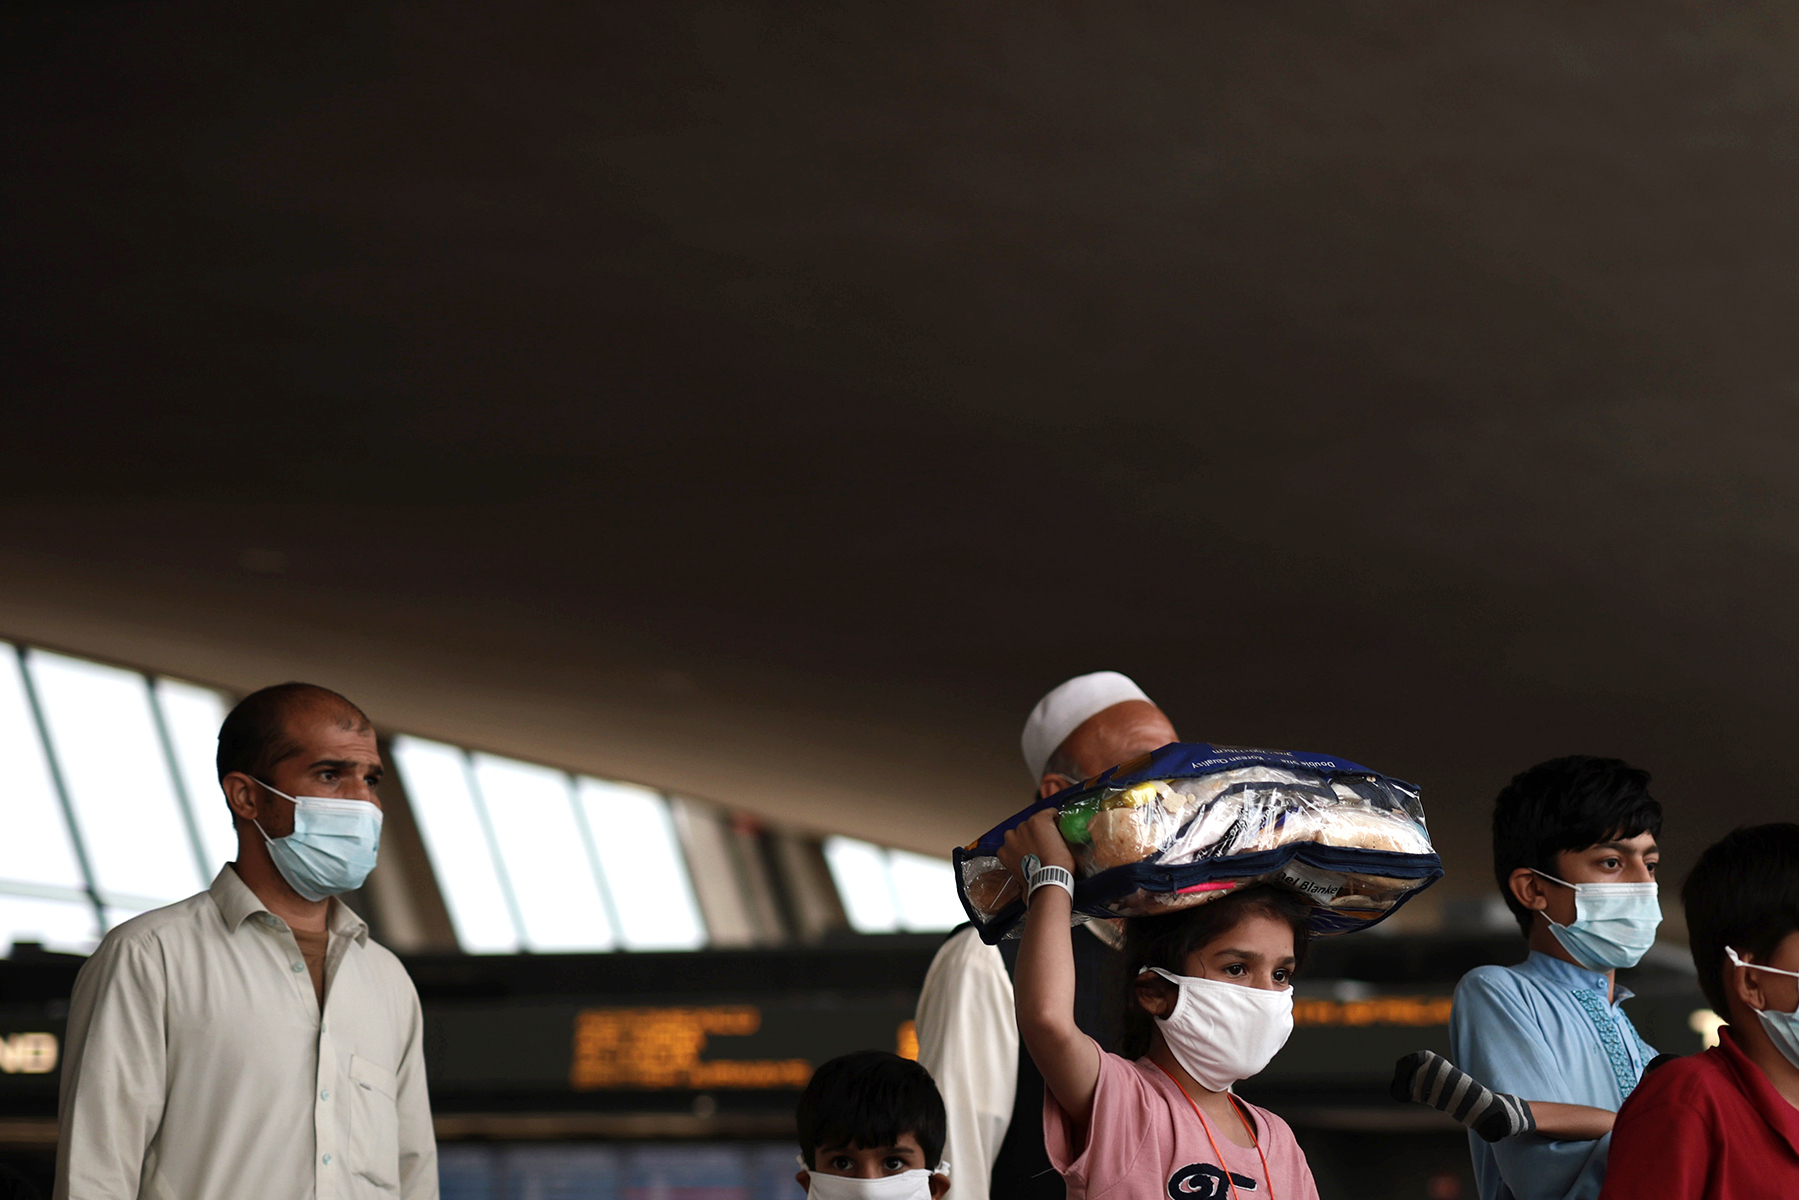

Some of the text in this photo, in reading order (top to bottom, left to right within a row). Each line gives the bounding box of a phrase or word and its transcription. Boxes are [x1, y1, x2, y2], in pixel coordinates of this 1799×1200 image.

[1191, 757, 1228, 769] Quality
[1300, 760, 1336, 769] Double
[1299, 880, 1343, 897] Blanket
